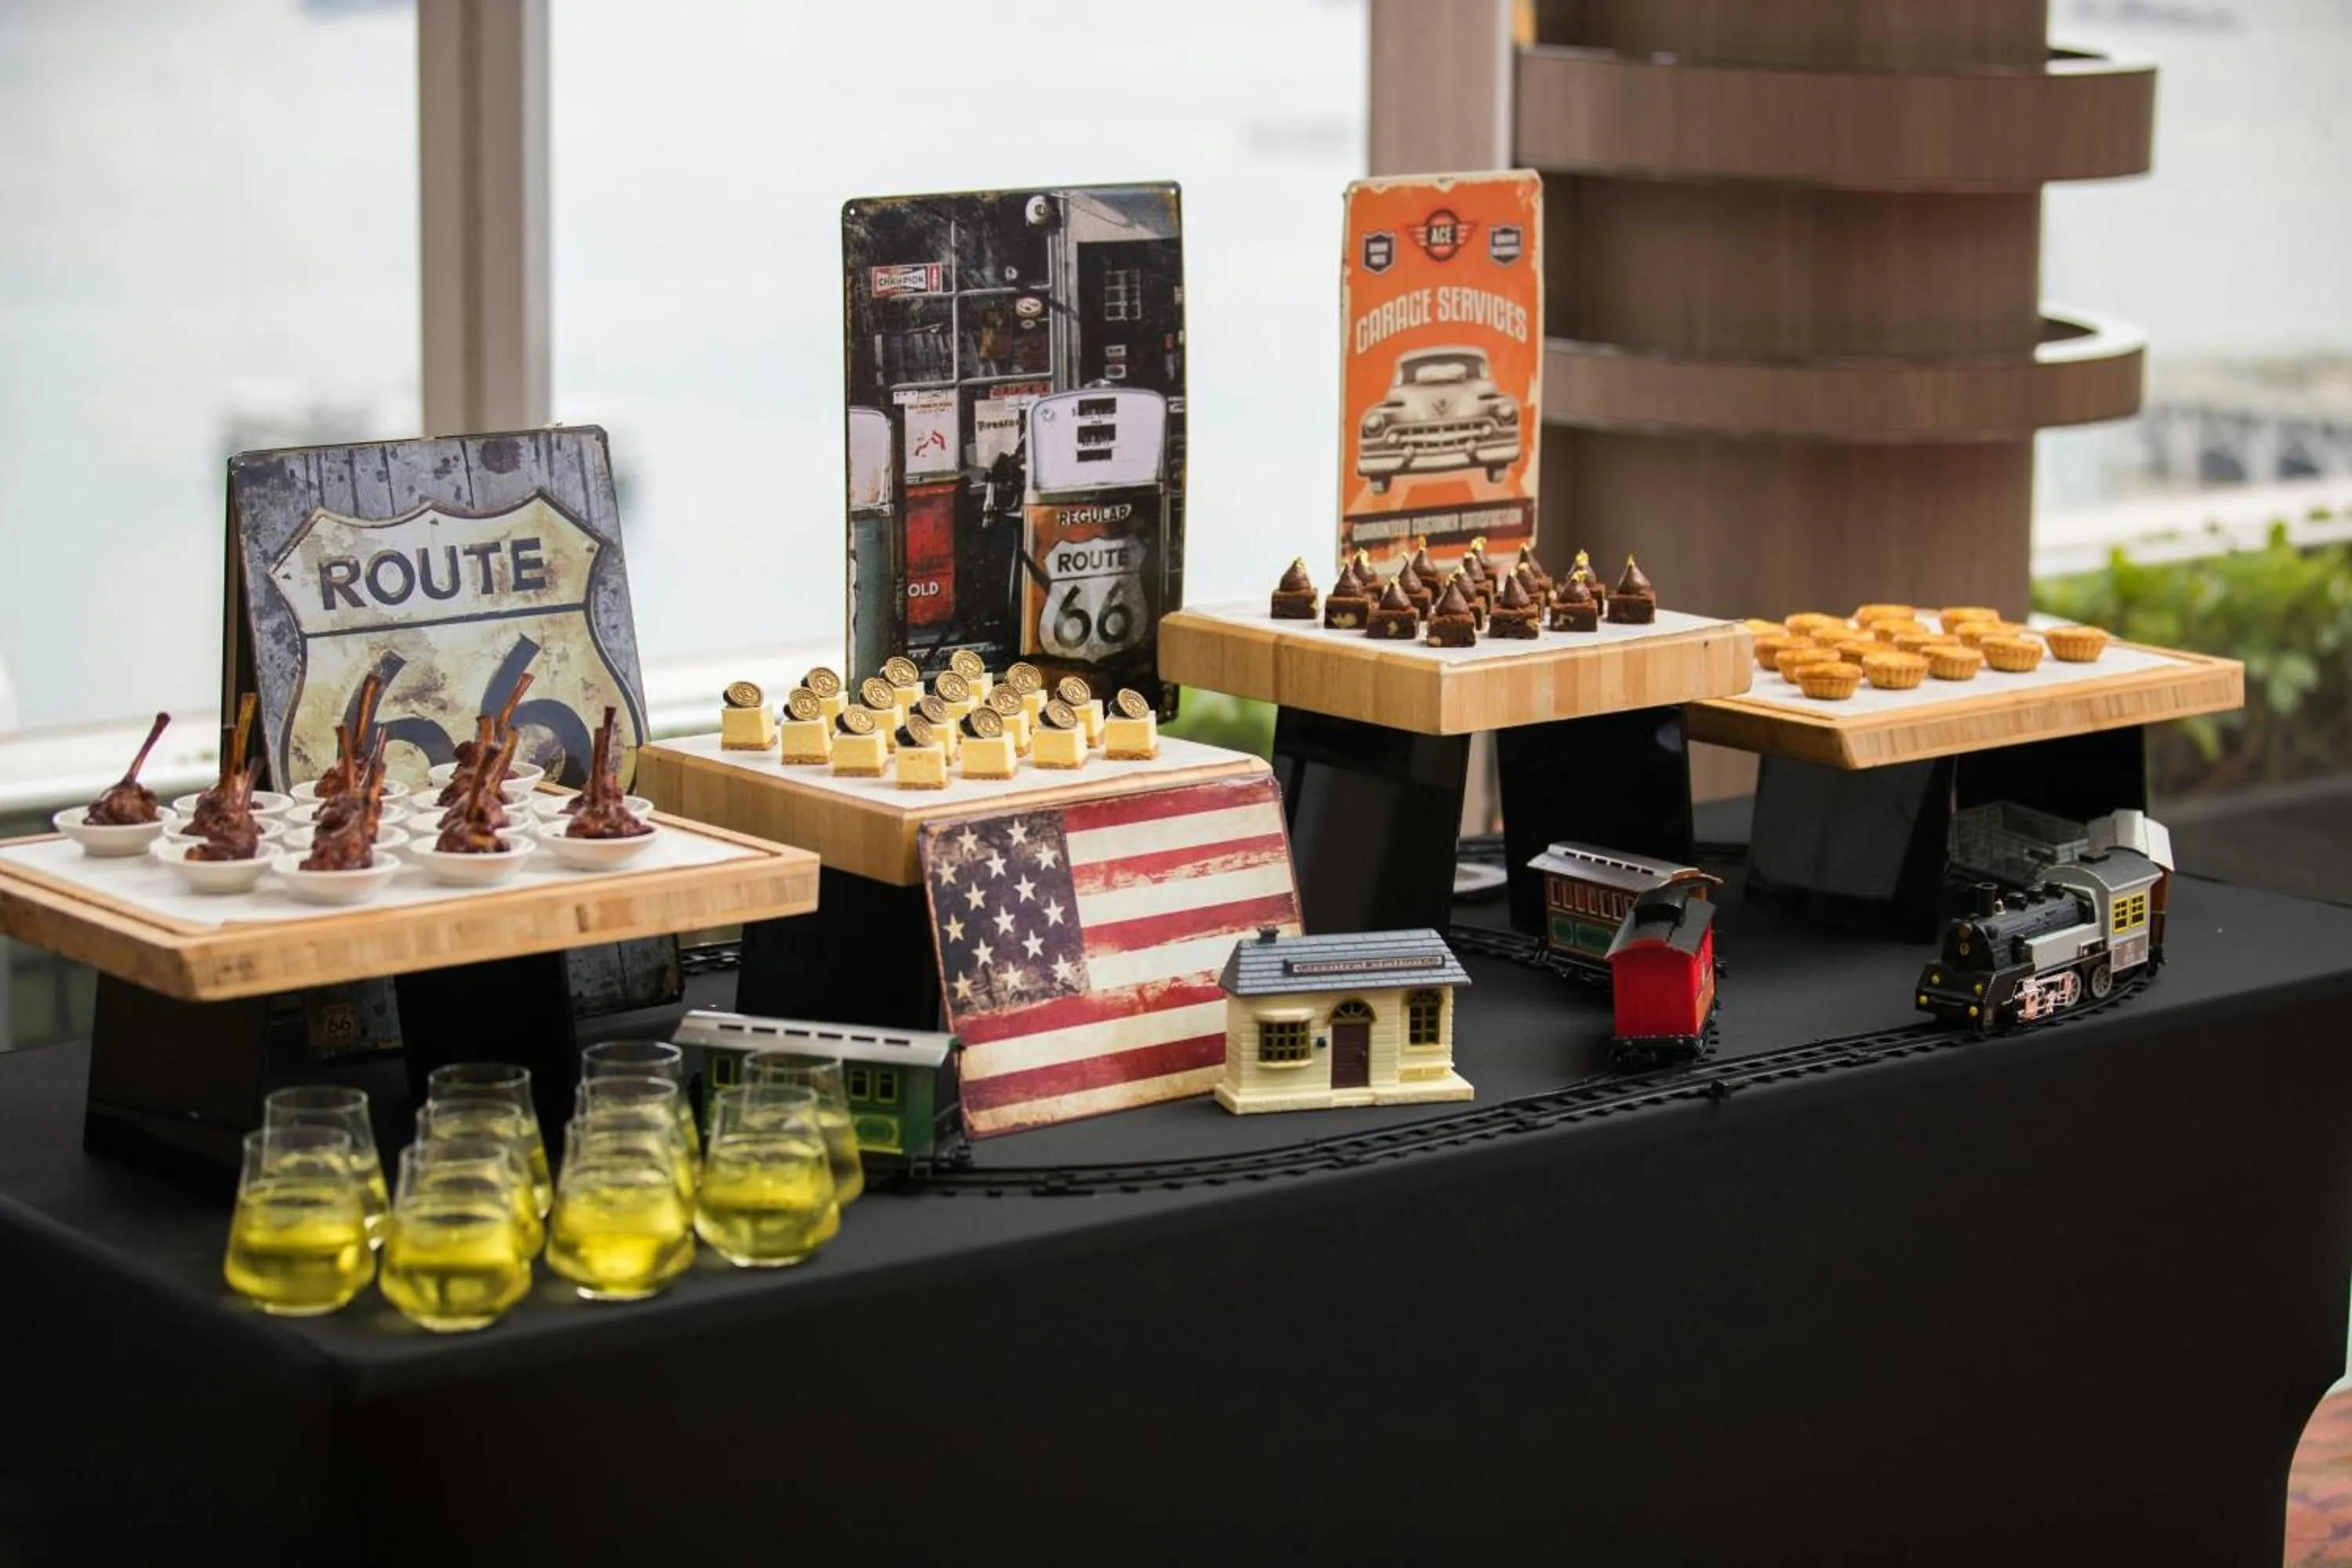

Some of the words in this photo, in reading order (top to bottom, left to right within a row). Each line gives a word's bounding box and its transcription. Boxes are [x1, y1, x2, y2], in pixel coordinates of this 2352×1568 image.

[878, 275, 924, 286] CHAMPION
[1356, 288, 1433, 354] GARAGE
[1436, 286, 1528, 344] SERVICES
[1058, 503, 1132, 527] REGULAR
[1058, 547, 1131, 573] ROUTE
[318, 537, 546, 611] ROUTE
[908, 581, 939, 597] OLD
[1054, 581, 1133, 648] 66
